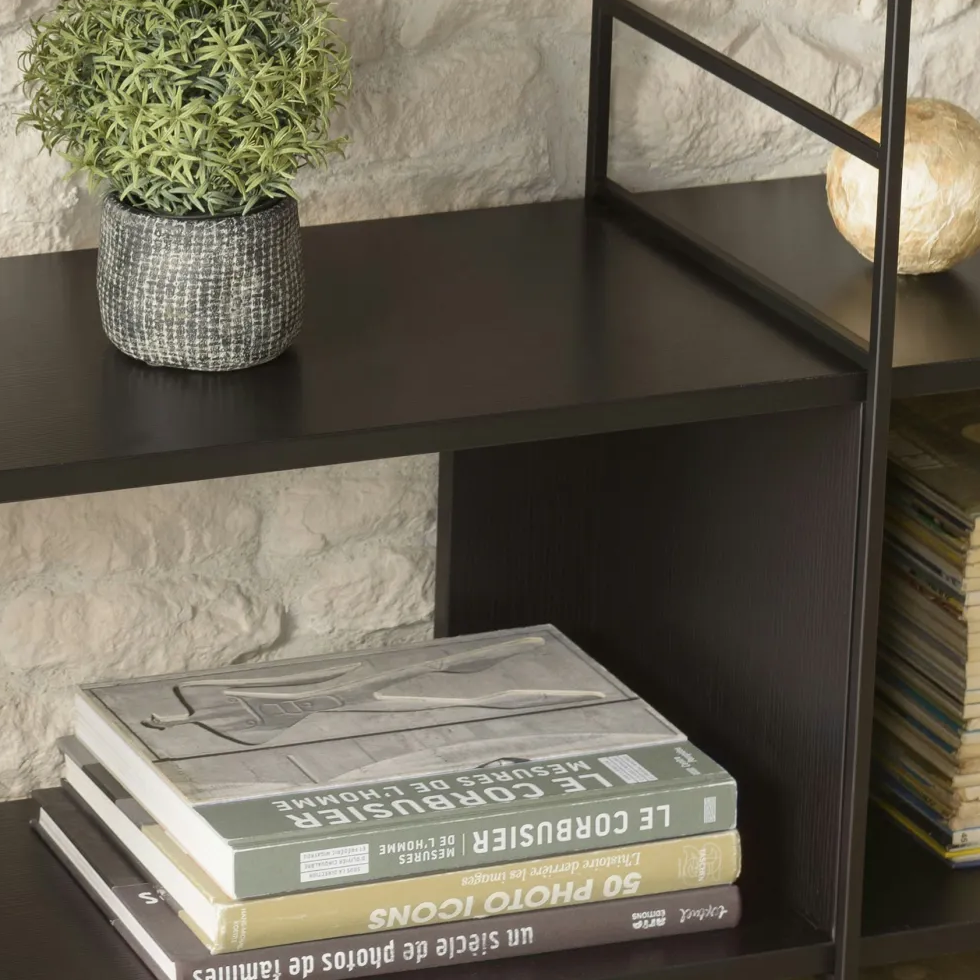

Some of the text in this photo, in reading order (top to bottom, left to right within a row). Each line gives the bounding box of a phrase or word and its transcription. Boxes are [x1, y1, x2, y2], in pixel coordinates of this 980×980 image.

[409, 779, 451, 793] DE
[456, 760, 592, 787] MESURES
[271, 785, 405, 812] L'HOMME
[285, 772, 613, 829] LE CORBUSIER
[639, 803, 671, 831] LE
[379, 834, 456, 855] DE L'HOMME
[472, 810, 629, 854] CORBUSIER
[398, 847, 456, 865] MESURES
[461, 851, 641, 887] L'histoire derrière les images
[367, 872, 643, 930] 50 PHOTO ICONS
[435, 930, 500, 960] siècle
[506, 926, 534, 947] un
[321, 939, 395, 972] photos
[402, 939, 428, 964] de
[288, 954, 315, 979] de
